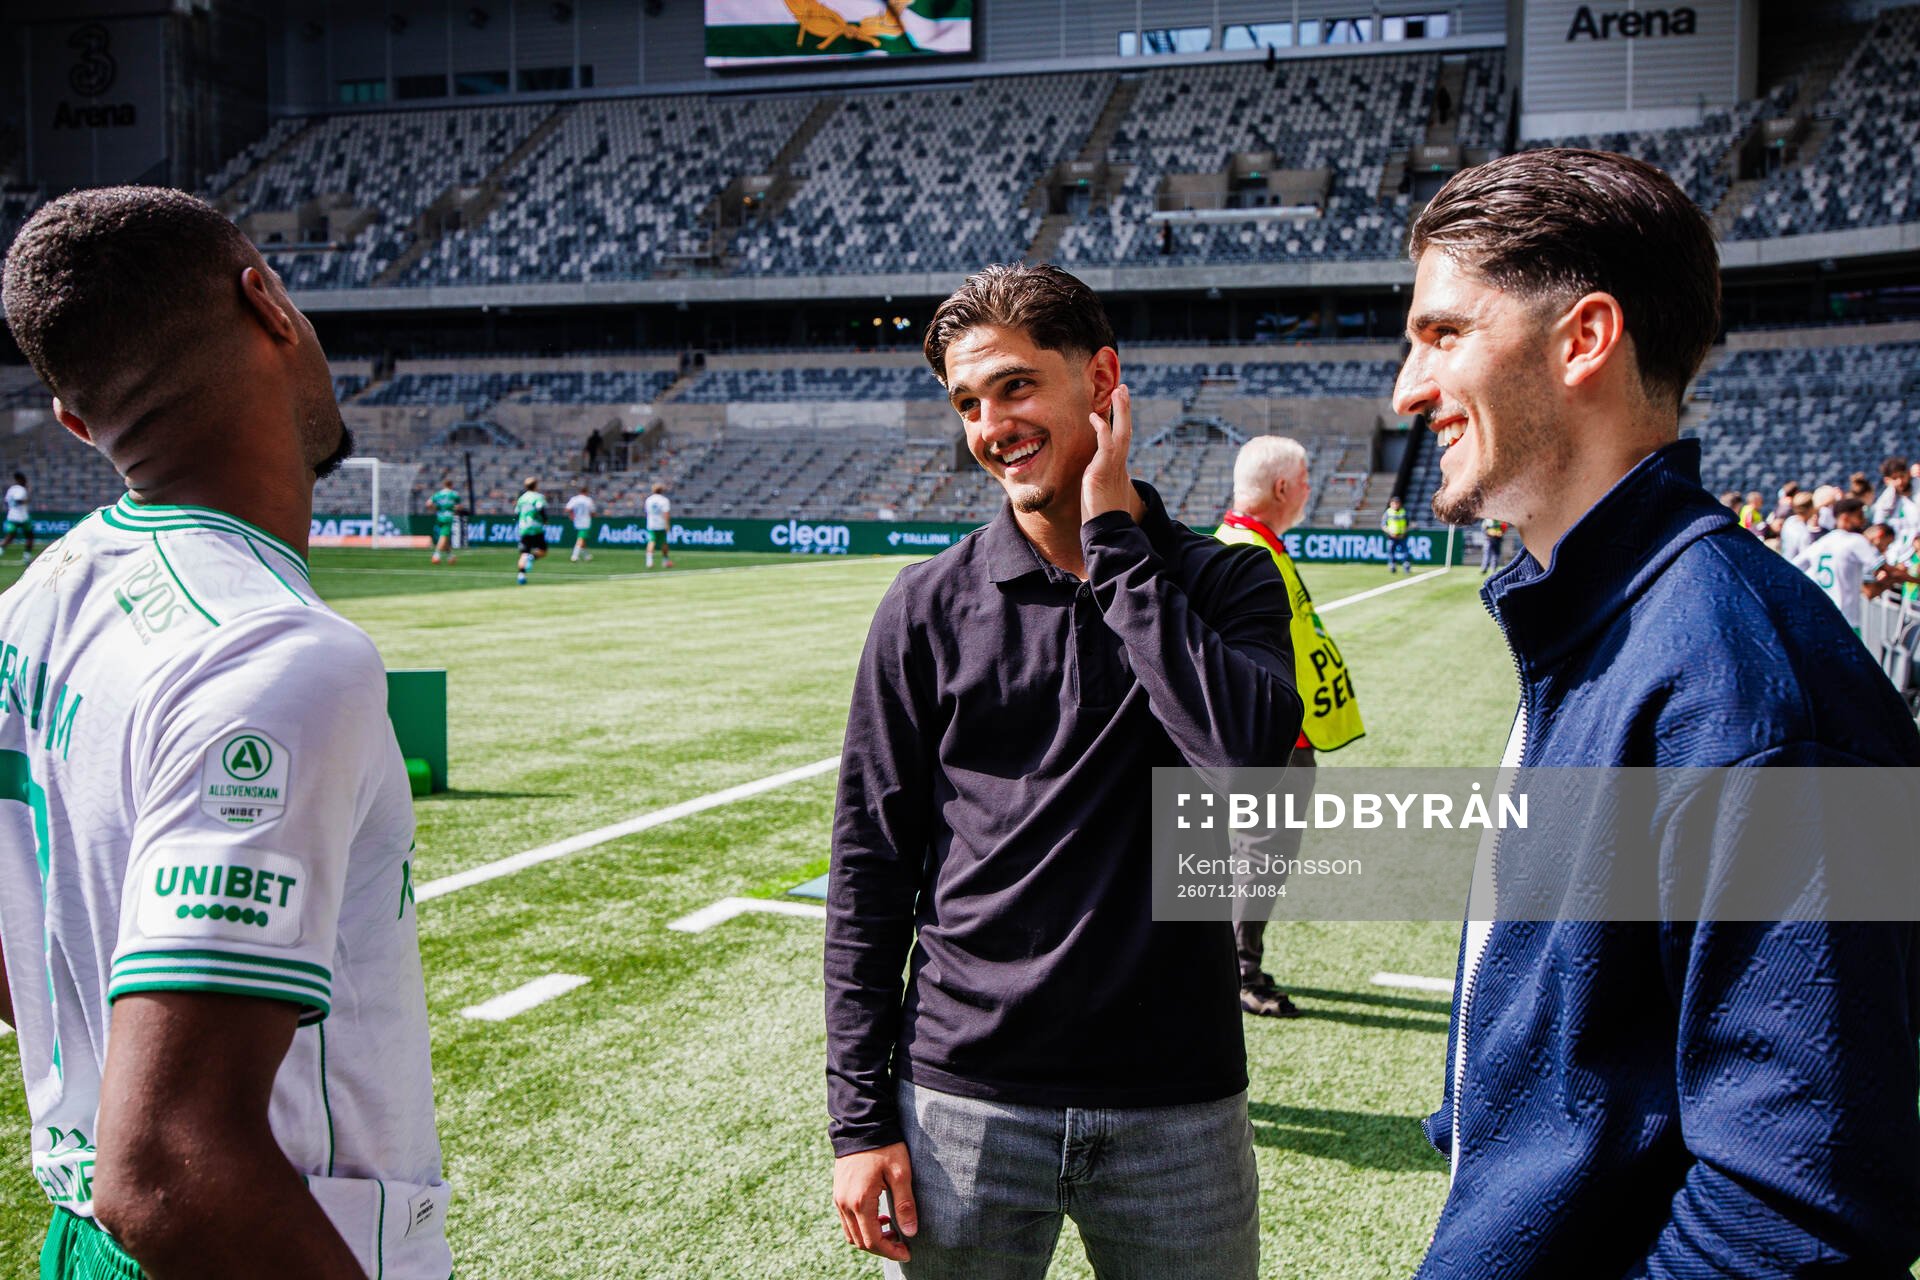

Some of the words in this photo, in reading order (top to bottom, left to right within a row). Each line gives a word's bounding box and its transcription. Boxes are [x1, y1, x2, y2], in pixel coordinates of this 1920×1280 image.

[1565, 6, 1697, 43] Arena
[53, 102, 136, 129] Arena
[309, 518, 374, 538] RAFT
[770, 519, 850, 546] clean
[1304, 533, 1390, 560] CENTRAL
[1817, 554, 1835, 589] 5
[208, 784, 280, 800] ALLSVENSKAN
[219, 807, 264, 817] UNIBET
[154, 864, 297, 908] UNIBET
